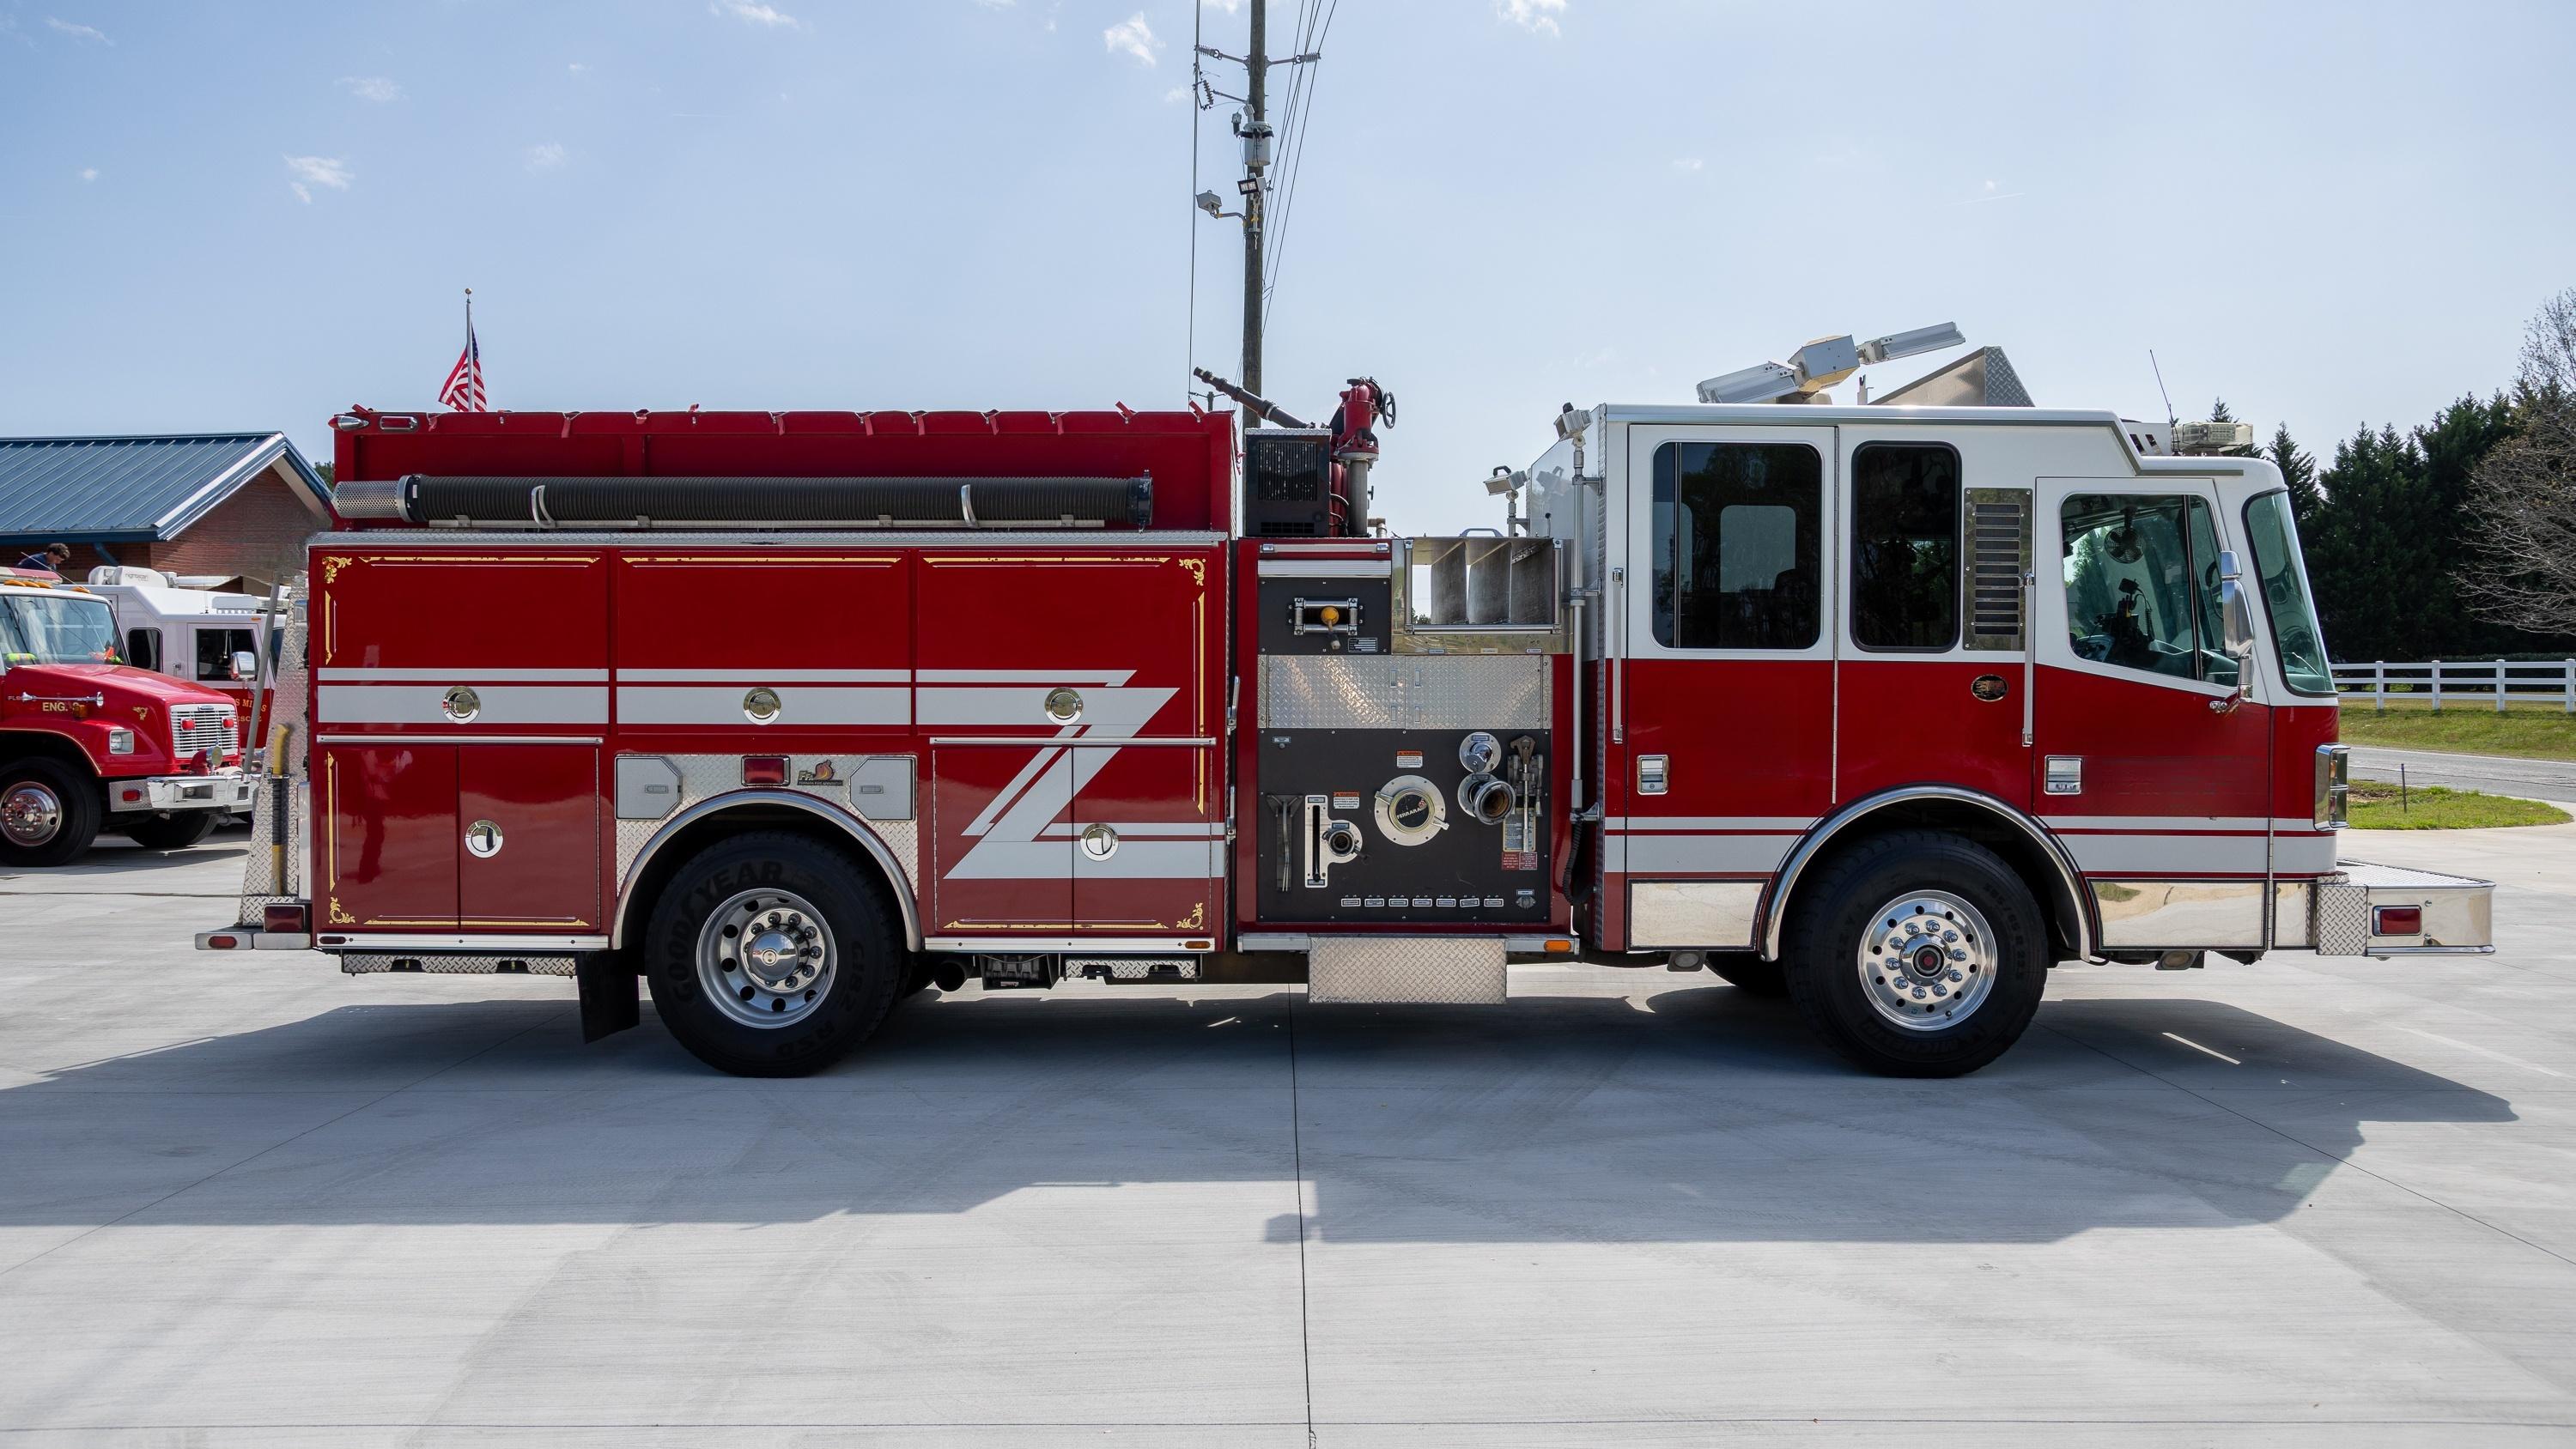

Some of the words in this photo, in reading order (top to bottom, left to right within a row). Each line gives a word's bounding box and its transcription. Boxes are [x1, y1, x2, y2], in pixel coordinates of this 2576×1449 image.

[42, 702, 68, 712] ENG.
[241, 699, 267, 712] MIS
[1396, 808, 1421, 819] FERRARA
